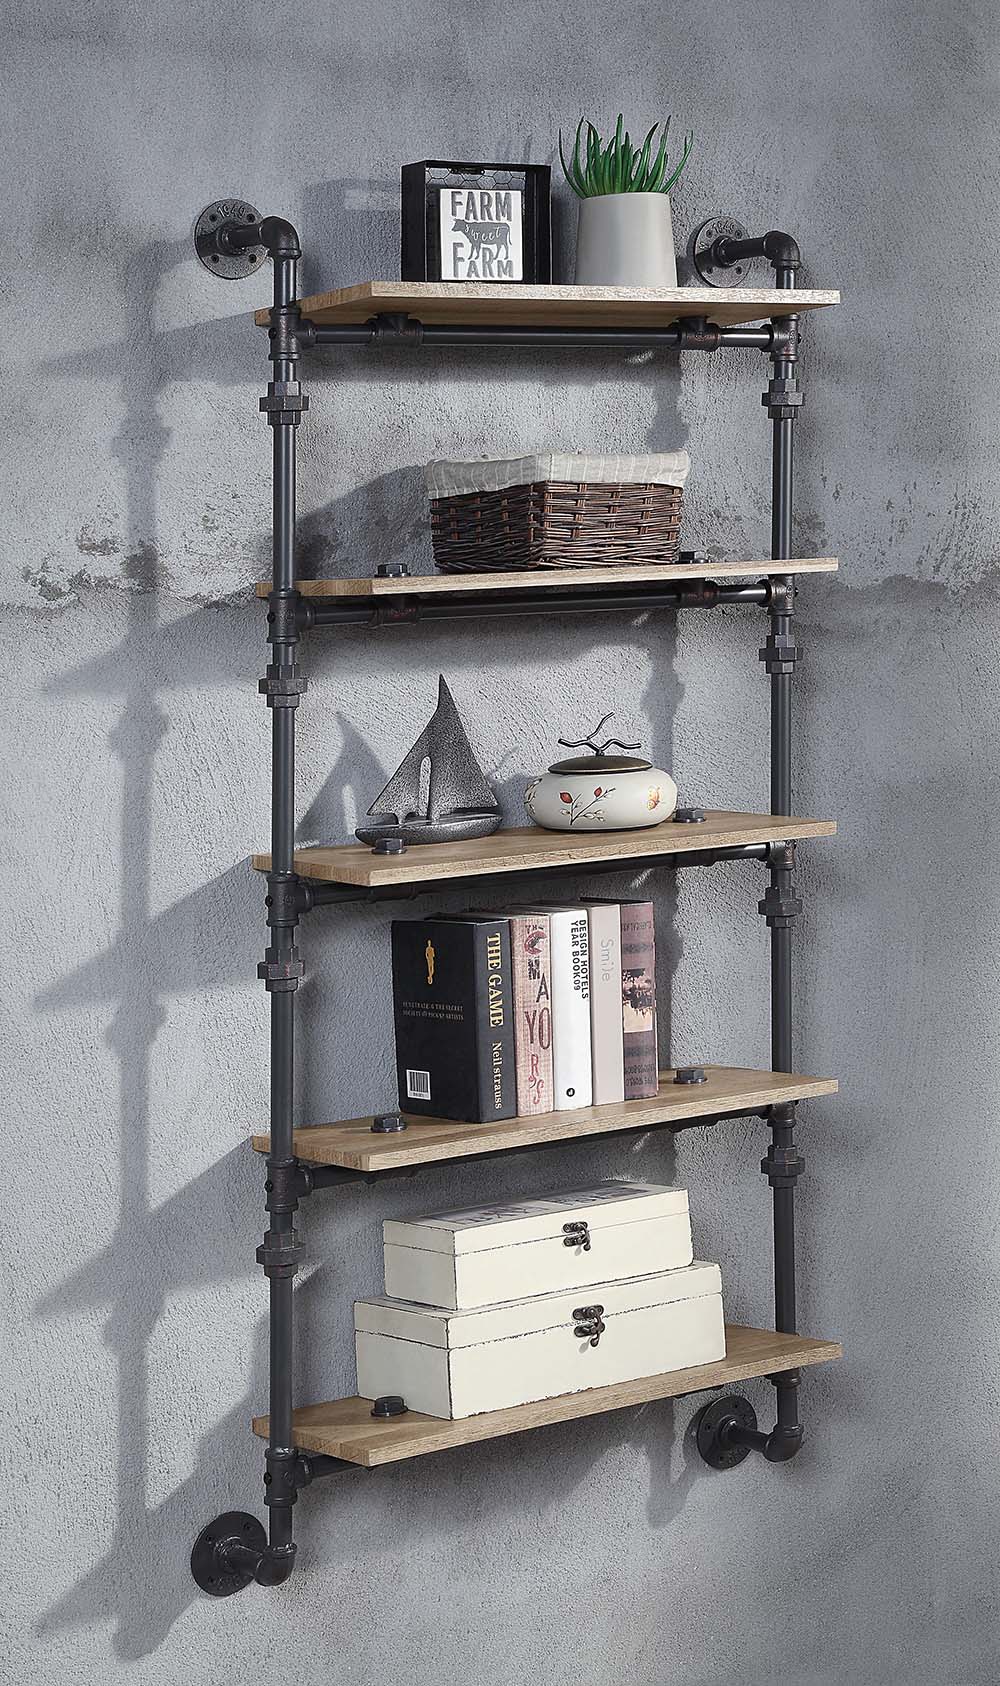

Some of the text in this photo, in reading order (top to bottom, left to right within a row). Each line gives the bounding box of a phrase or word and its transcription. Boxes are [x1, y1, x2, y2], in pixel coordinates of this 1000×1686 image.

[451, 190, 512, 221] FARM
[452, 242, 514, 278] FARM
[570, 920, 580, 947] YEAR
[578, 919, 589, 1000] DESIGN HOTELS
[600, 938, 615, 982] Smile
[487, 932, 504, 1028] THE GAME
[492, 1040, 504, 1066] Neil
